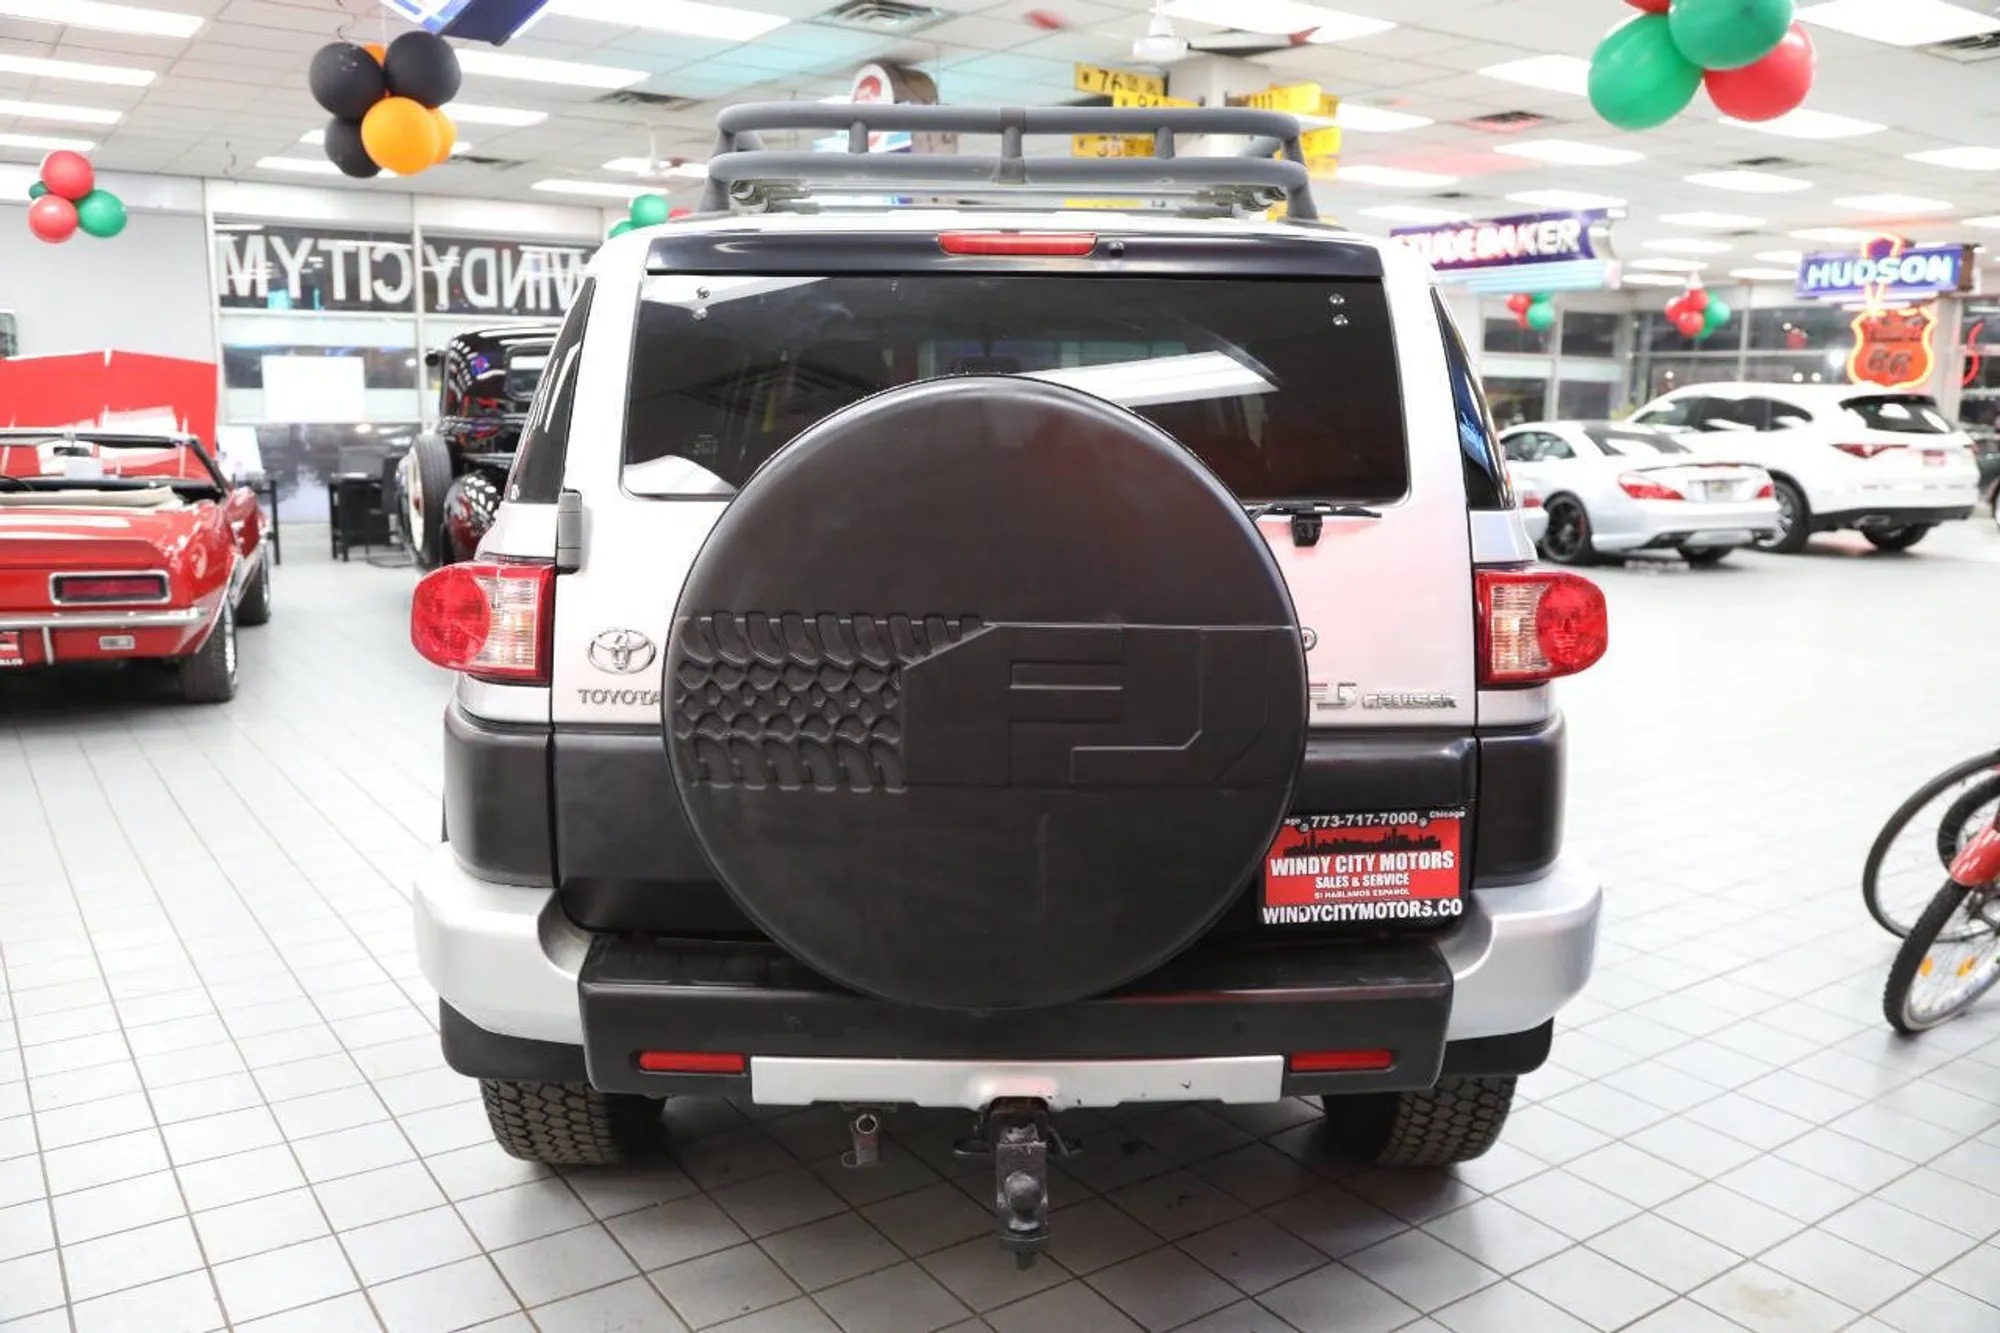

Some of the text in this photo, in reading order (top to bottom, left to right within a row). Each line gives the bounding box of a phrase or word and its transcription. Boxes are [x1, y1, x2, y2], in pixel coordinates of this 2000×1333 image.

[1807, 254, 1953, 289] HUDSON
[1867, 347, 1913, 376] 66
[1311, 812, 1418, 828] 773-717-7000
[1429, 810, 1466, 820] Chicago
[1271, 851, 1454, 876] WINDY CITY MOTORS
[1315, 873, 1410, 889] SALES & SERVICE
[1263, 899, 1463, 924] WINDYCITYMOTORS.CO
